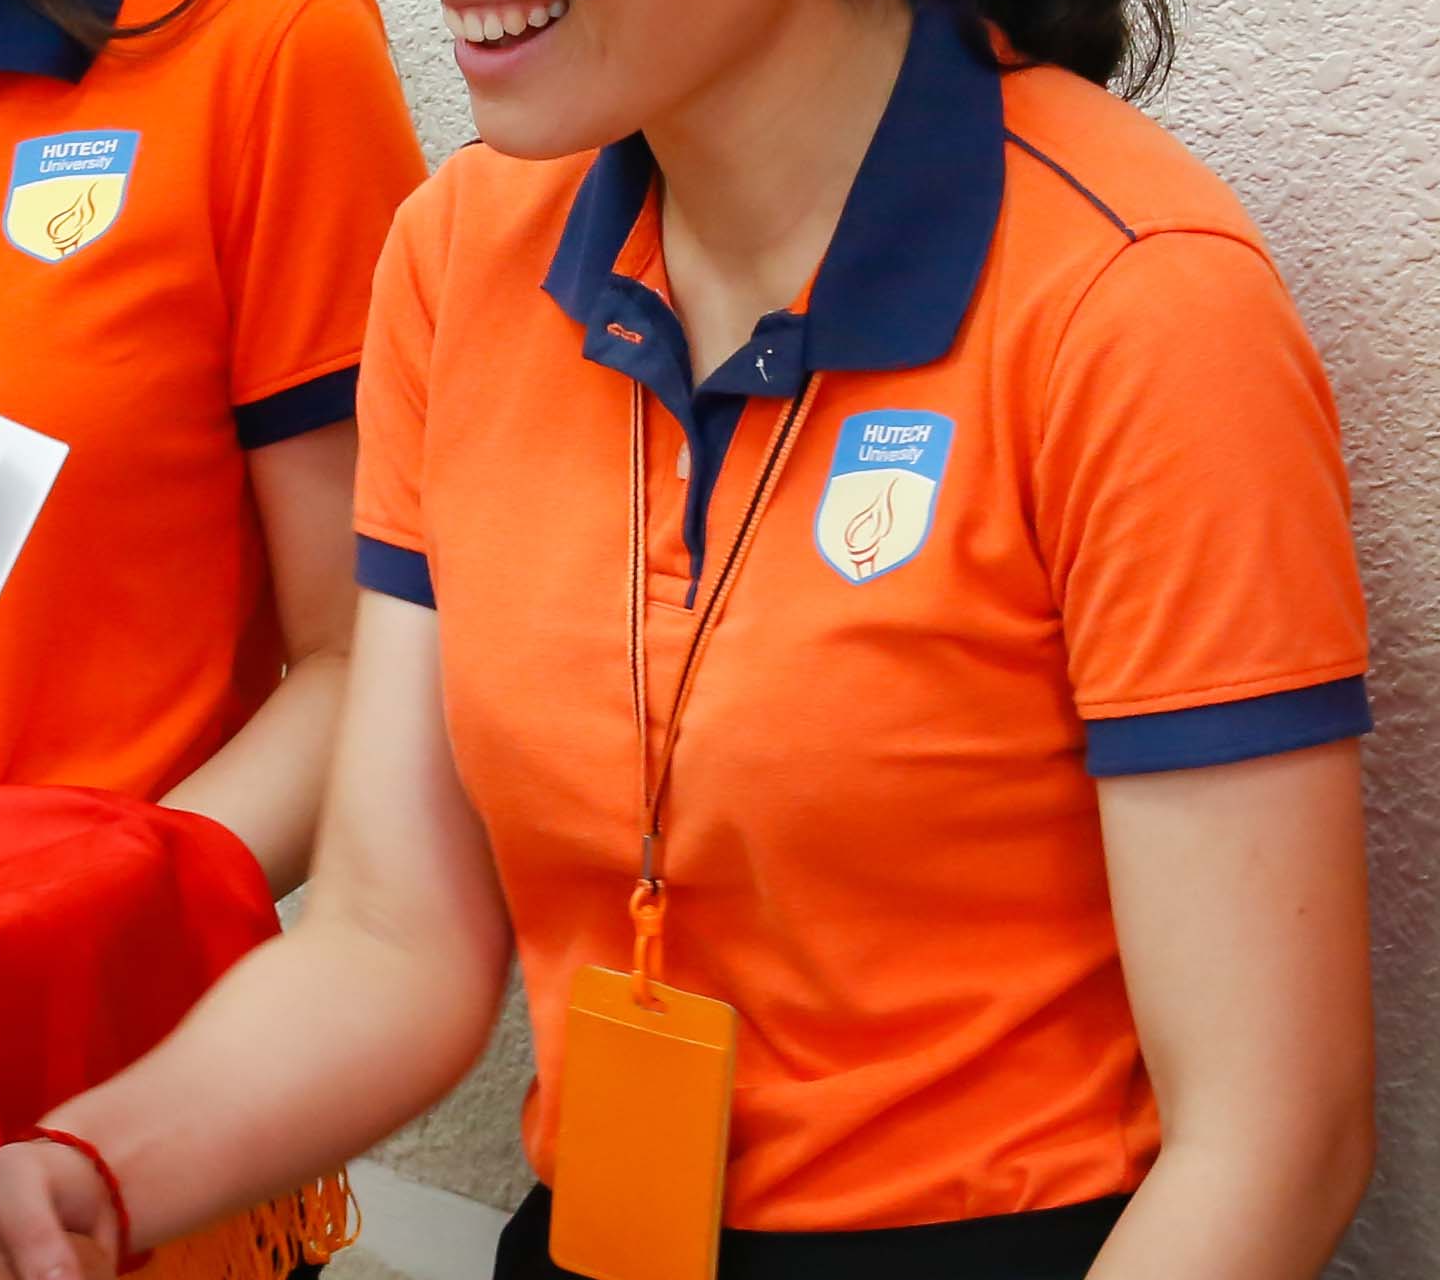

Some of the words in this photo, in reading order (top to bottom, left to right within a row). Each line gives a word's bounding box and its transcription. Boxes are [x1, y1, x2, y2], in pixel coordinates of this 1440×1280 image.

[42, 139, 118, 157] HUTECH
[39, 158, 113, 173] University
[863, 425, 932, 444] HUTECH
